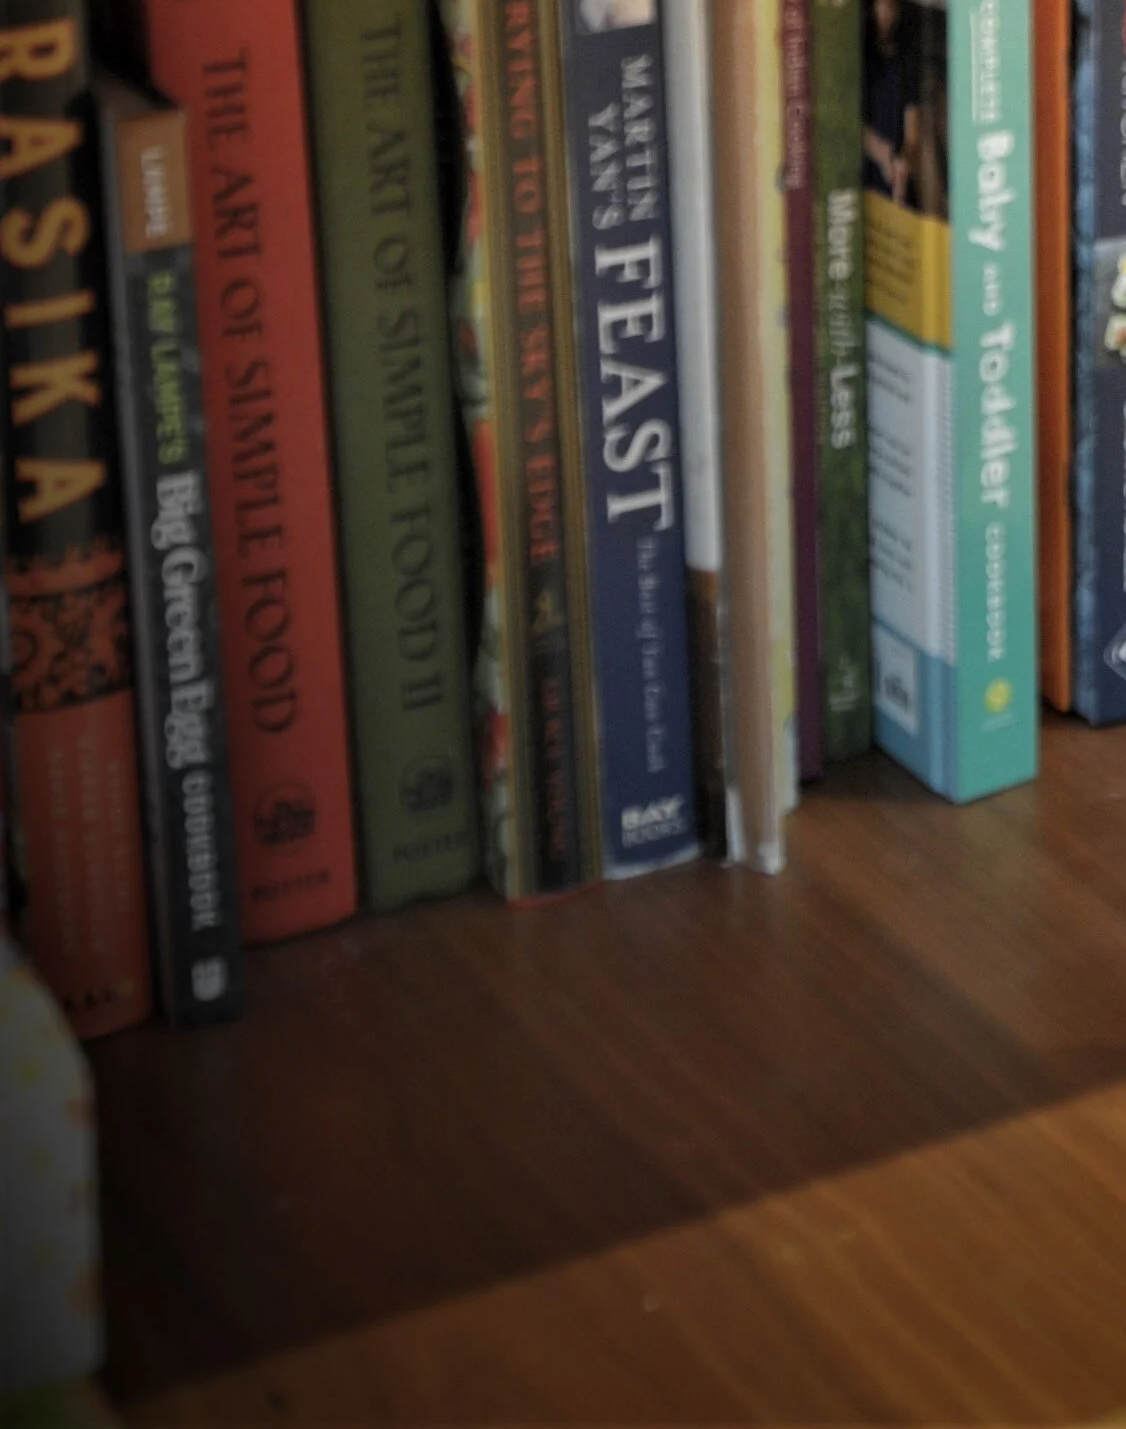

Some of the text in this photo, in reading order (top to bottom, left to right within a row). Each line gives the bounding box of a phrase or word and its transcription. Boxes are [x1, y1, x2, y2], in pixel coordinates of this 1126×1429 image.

[784, 34, 807, 95] Indian
[978, 1, 1002, 123] COMPLETE
[512, 155, 544, 213] TO
[588, 103, 625, 231] YAN'S
[619, 56, 660, 222] MARTIN
[779, 97, 808, 190] Cooking
[968, 130, 1015, 251] Baby
[0, 17, 106, 523] RASIKA
[516, 229, 549, 311] THE
[982, 261, 1001, 316] AND
[202, 43, 300, 737] THE ART OF SIMPLE FOOD
[359, 15, 445, 714] THE ART OF SIMPLE FOOD II
[594, 233, 676, 532] FEAST
[977, 320, 1019, 509] Toddler
[151, 471, 204, 550] Big
[524, 455, 561, 565] EDGE
[160, 547, 211, 683] Green
[983, 520, 1007, 662] COOKBOOK
[164, 678, 215, 769] Egg
[182, 769, 220, 932] COOKBOOK
